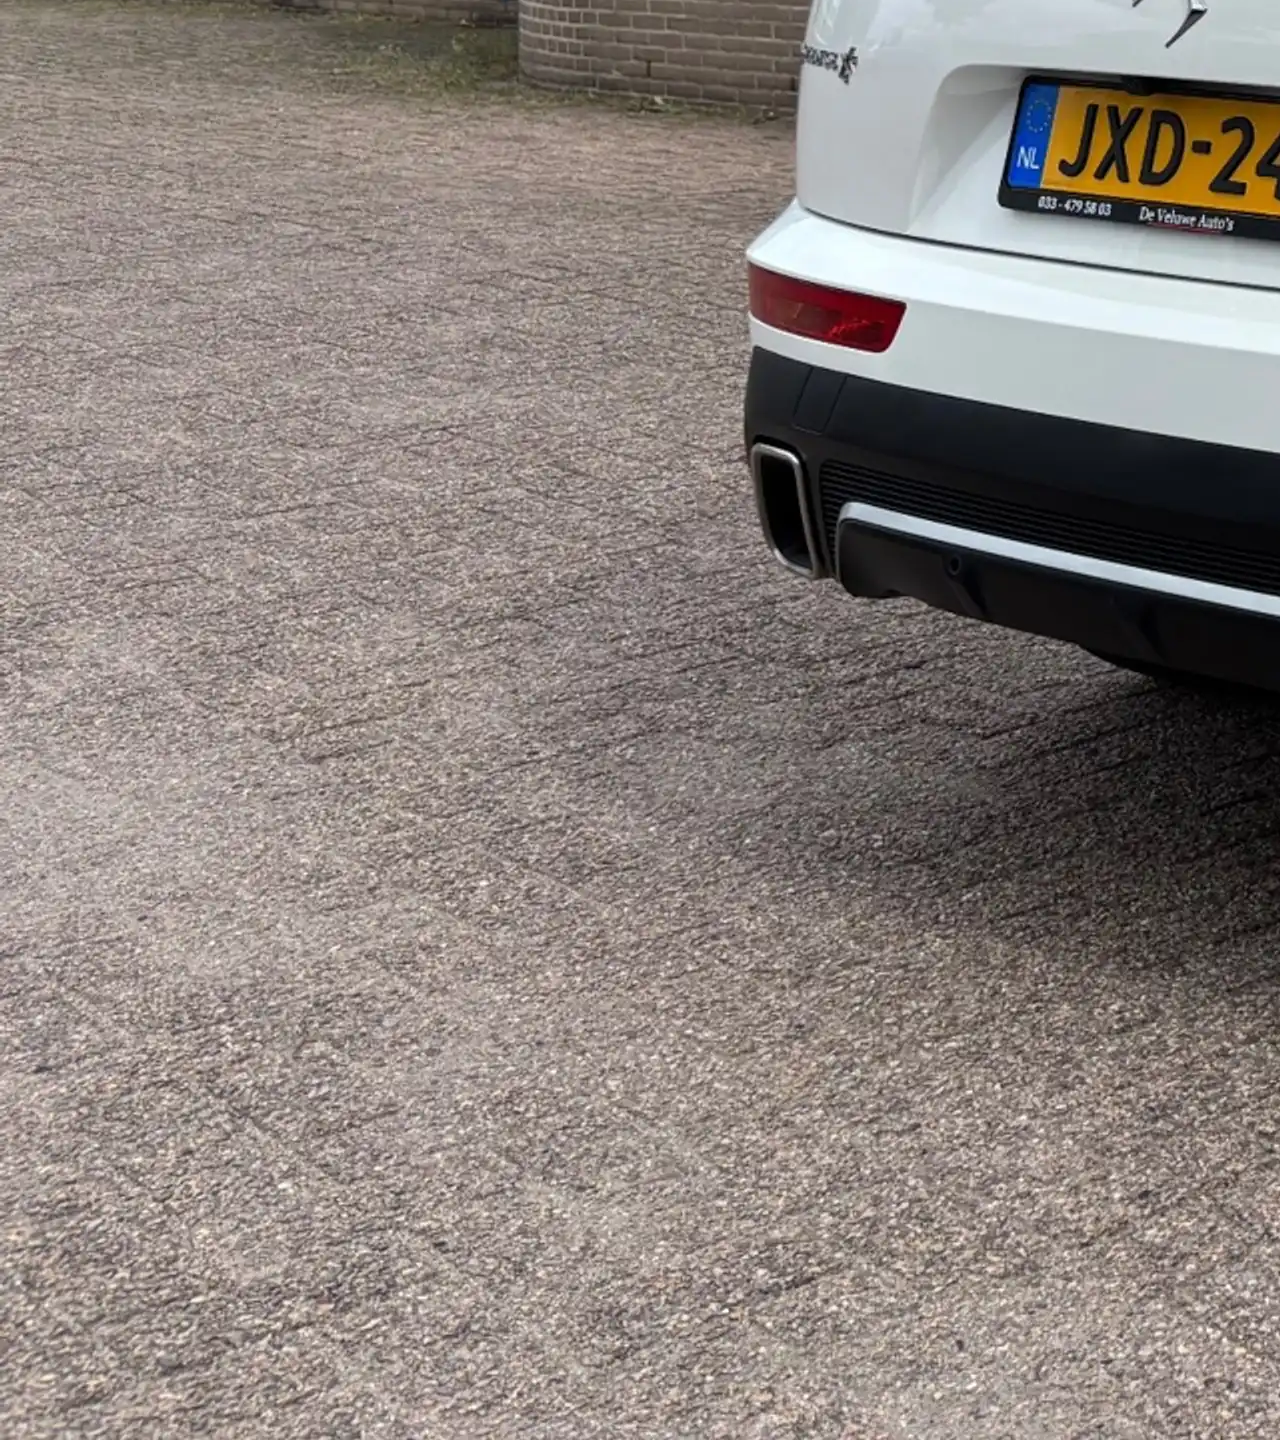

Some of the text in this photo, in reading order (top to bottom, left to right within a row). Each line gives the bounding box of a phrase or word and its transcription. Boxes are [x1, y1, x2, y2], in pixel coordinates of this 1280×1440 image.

[1016, 146, 1040, 169] NL
[1139, 205, 1236, 232] De Veluwe Auto's
